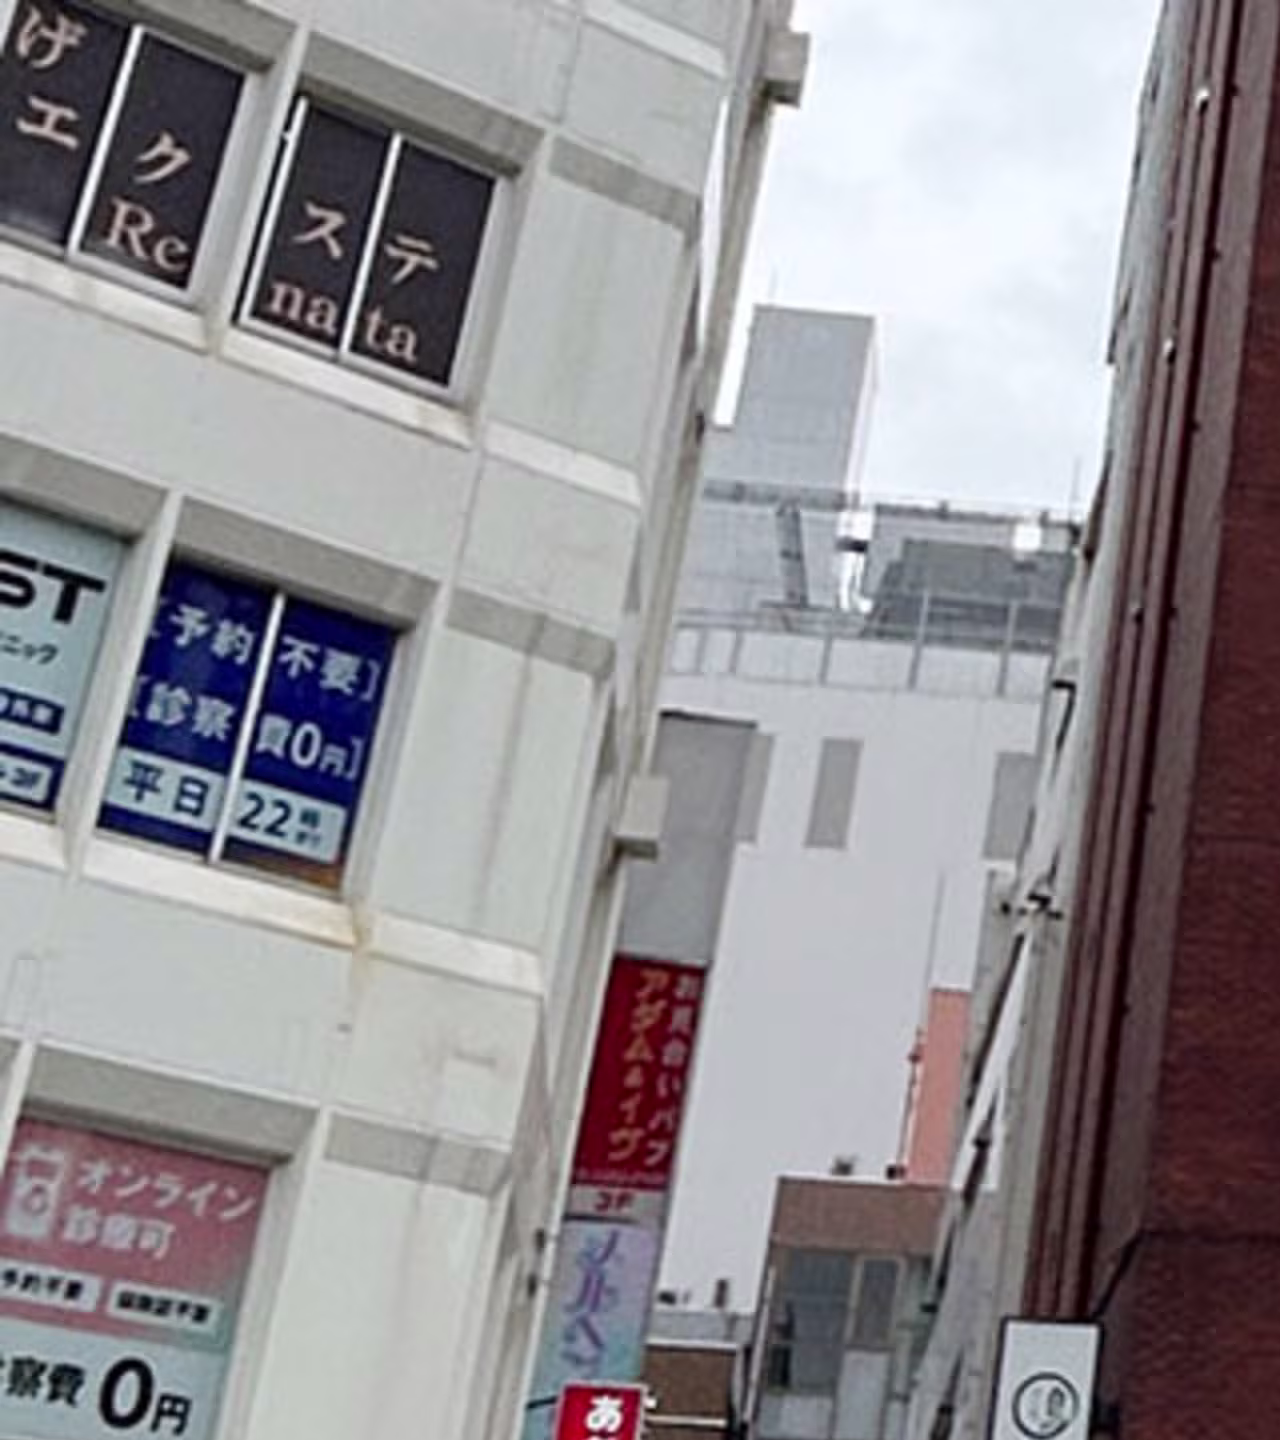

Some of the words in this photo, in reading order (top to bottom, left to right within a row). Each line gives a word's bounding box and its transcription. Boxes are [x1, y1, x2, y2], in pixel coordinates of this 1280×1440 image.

[77, 1157, 257, 1222] オンライン
[0, 1353, 193, 1437] 察費0円
